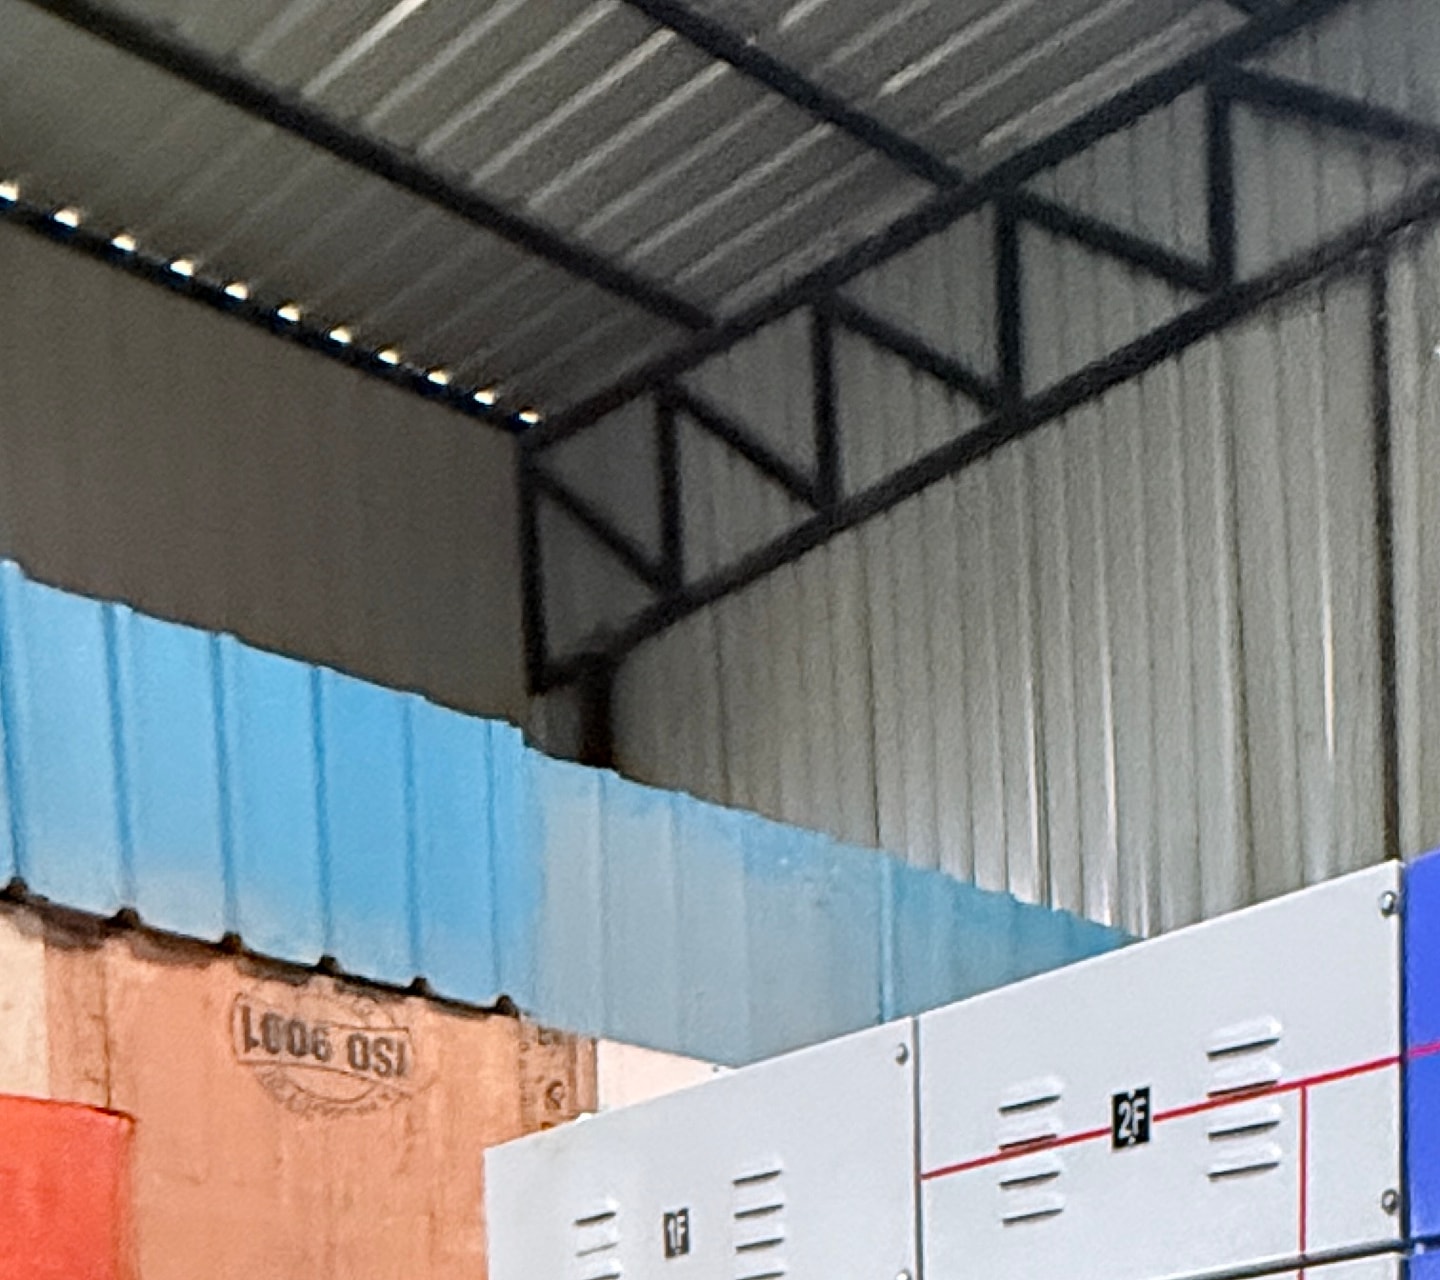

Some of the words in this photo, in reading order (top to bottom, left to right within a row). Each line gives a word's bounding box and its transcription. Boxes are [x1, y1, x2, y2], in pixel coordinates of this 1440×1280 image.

[240, 1004, 332, 1064] 9001
[347, 1033, 409, 1079] ISO
[1118, 1097, 1146, 1139] 2F
[667, 1215, 686, 1249] 1F
